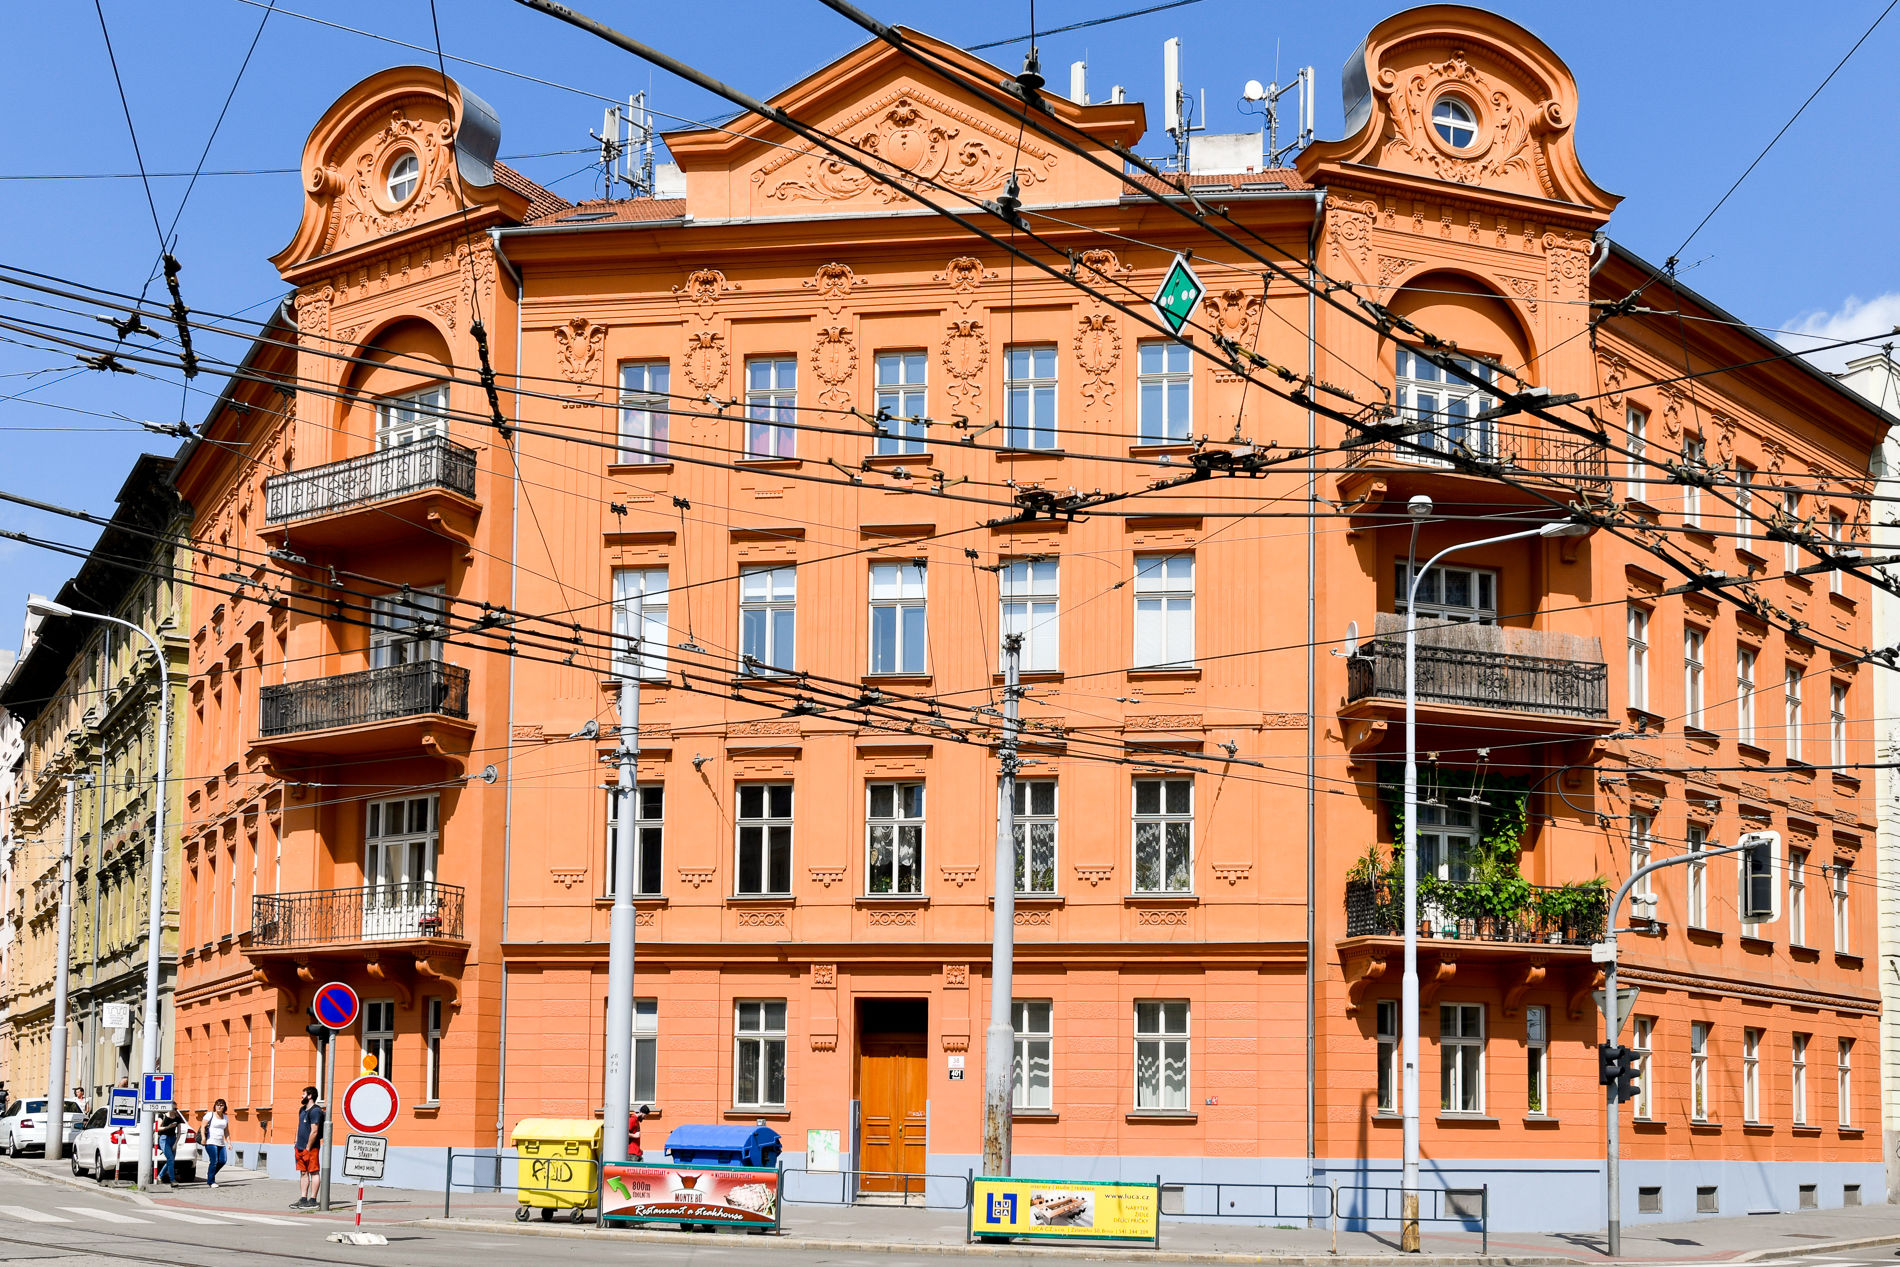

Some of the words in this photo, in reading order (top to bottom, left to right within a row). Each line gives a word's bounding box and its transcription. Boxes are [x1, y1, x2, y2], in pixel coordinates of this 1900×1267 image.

[632, 1181, 651, 1191] 800m
[674, 1193, 693, 1203] MONTE
[635, 1205, 687, 1216] Restaurant
[695, 1207, 744, 1220] steakhouse
